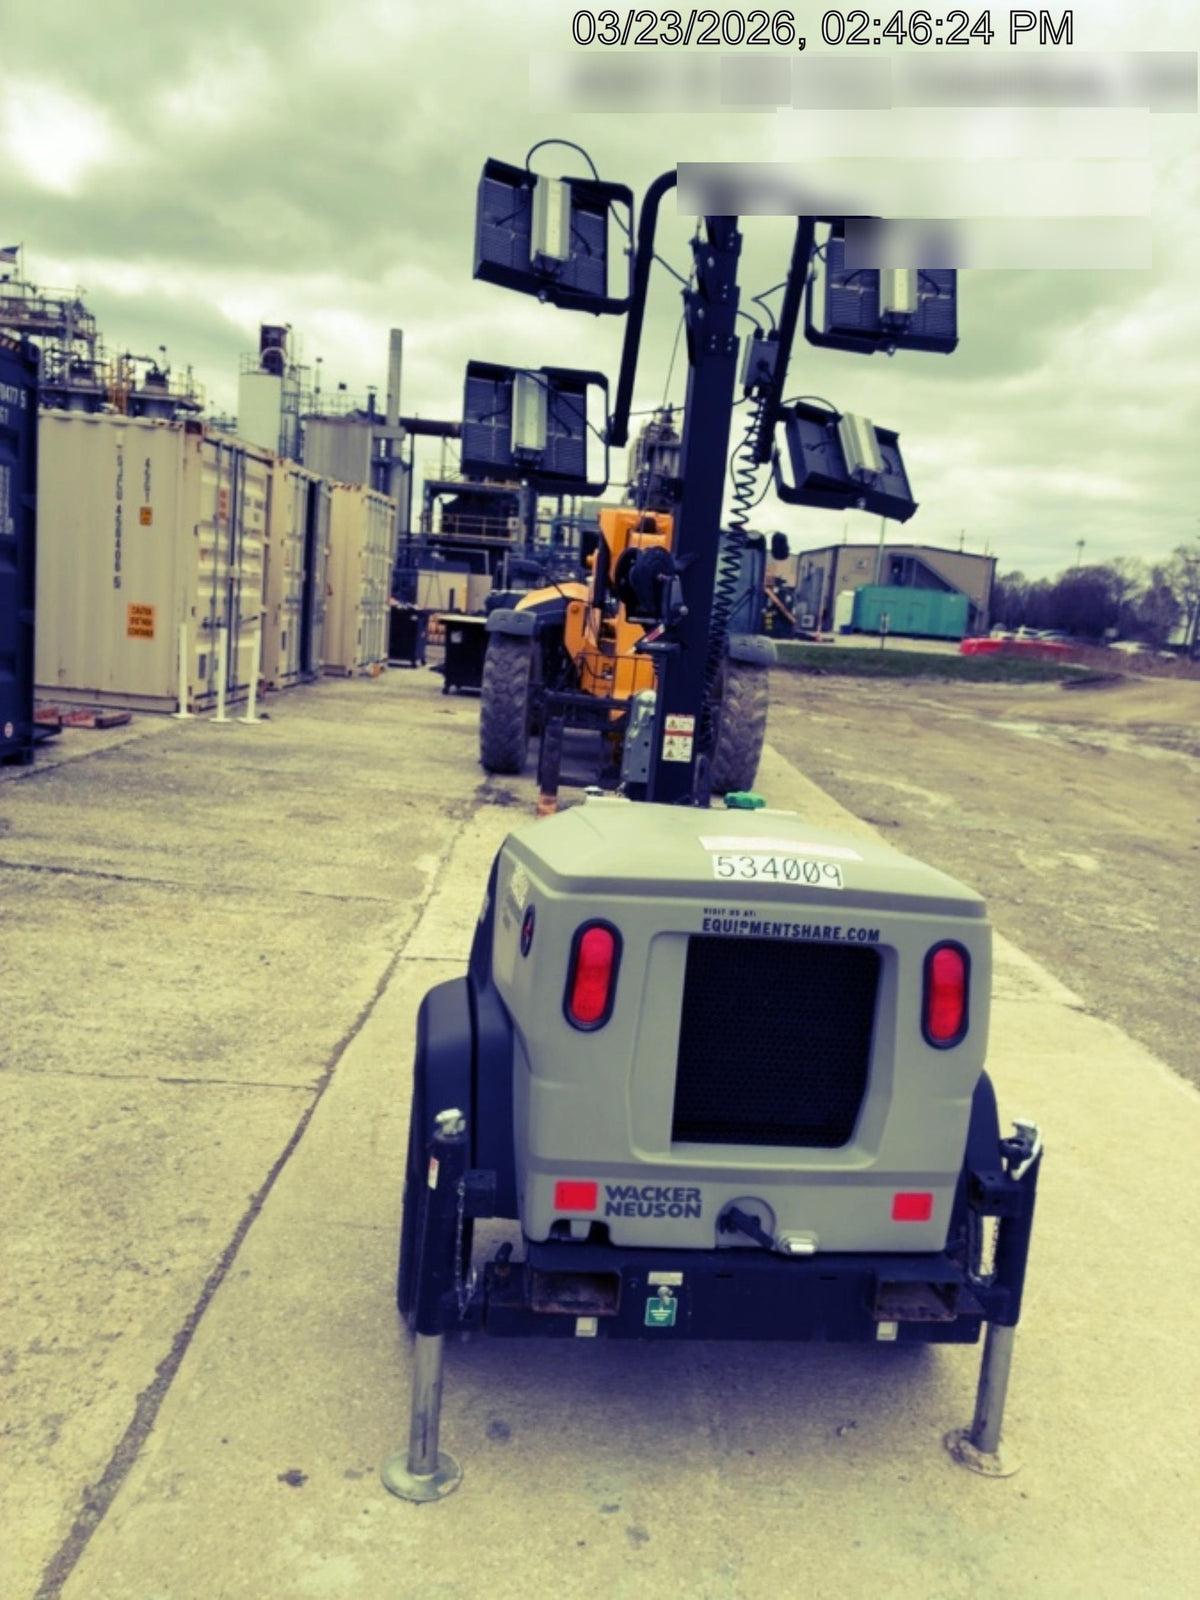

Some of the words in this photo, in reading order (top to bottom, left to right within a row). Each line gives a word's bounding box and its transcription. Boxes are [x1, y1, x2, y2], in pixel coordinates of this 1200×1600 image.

[717, 856, 842, 887] 534009
[729, 909, 740, 917] US
[702, 917, 880, 942] EQUIPMENTSHARE.COM
[604, 1185, 702, 1203] WACKER
[604, 1201, 702, 1219] NEUSON
